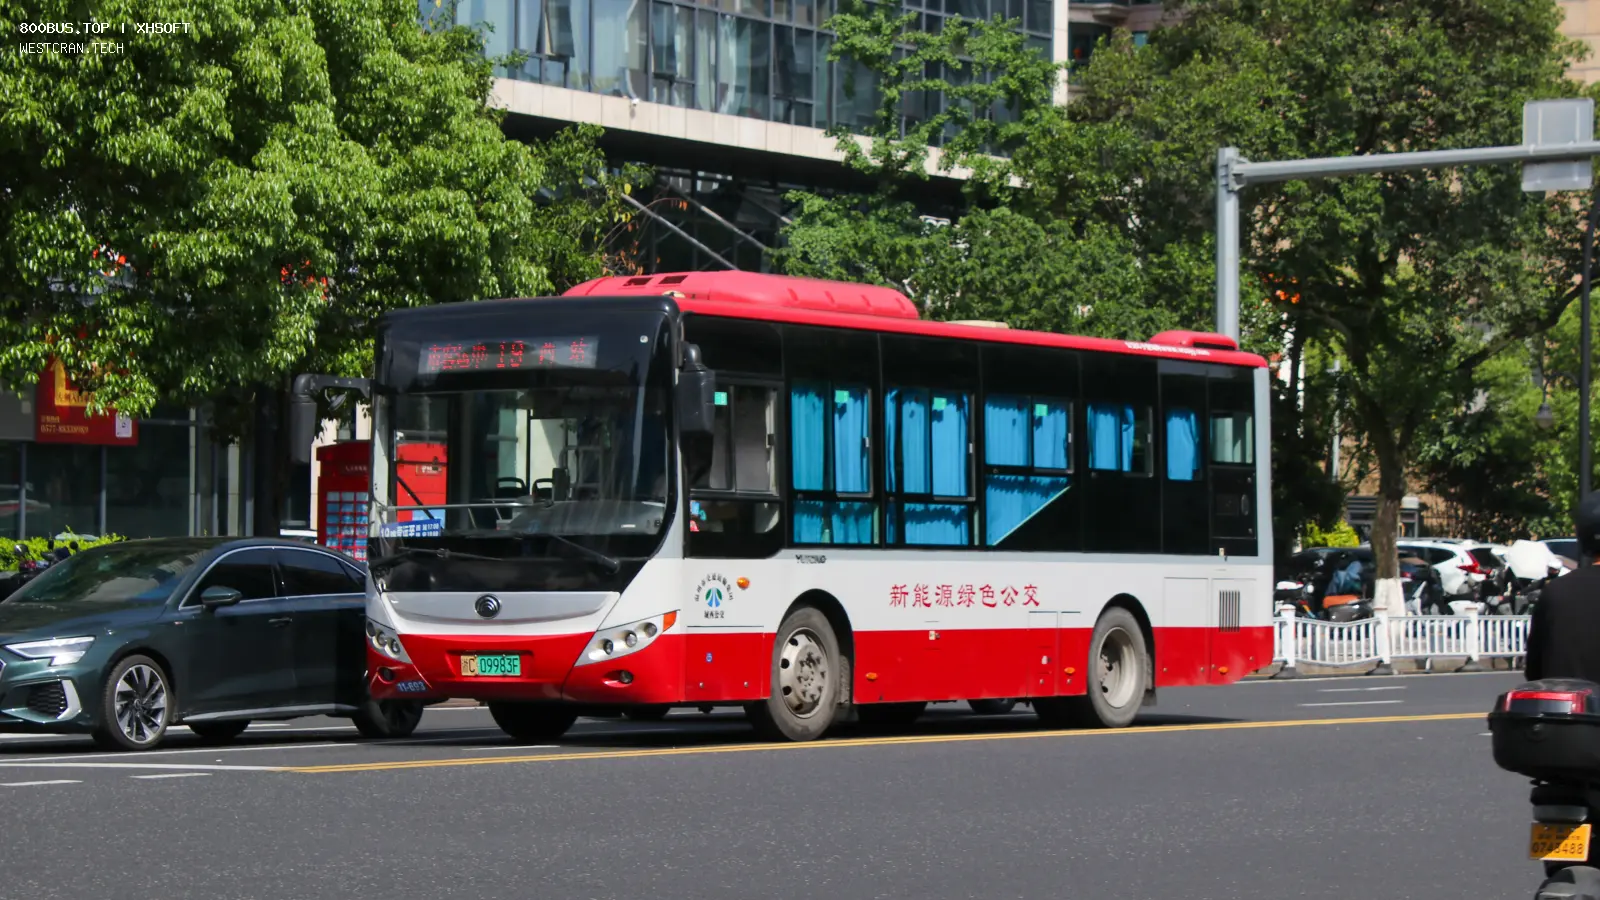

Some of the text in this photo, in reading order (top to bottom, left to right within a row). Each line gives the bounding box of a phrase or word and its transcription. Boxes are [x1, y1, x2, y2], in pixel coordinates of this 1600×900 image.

[889, 583, 1041, 609] 新能源绿色公交
[479, 657, 519, 673] 09983F
